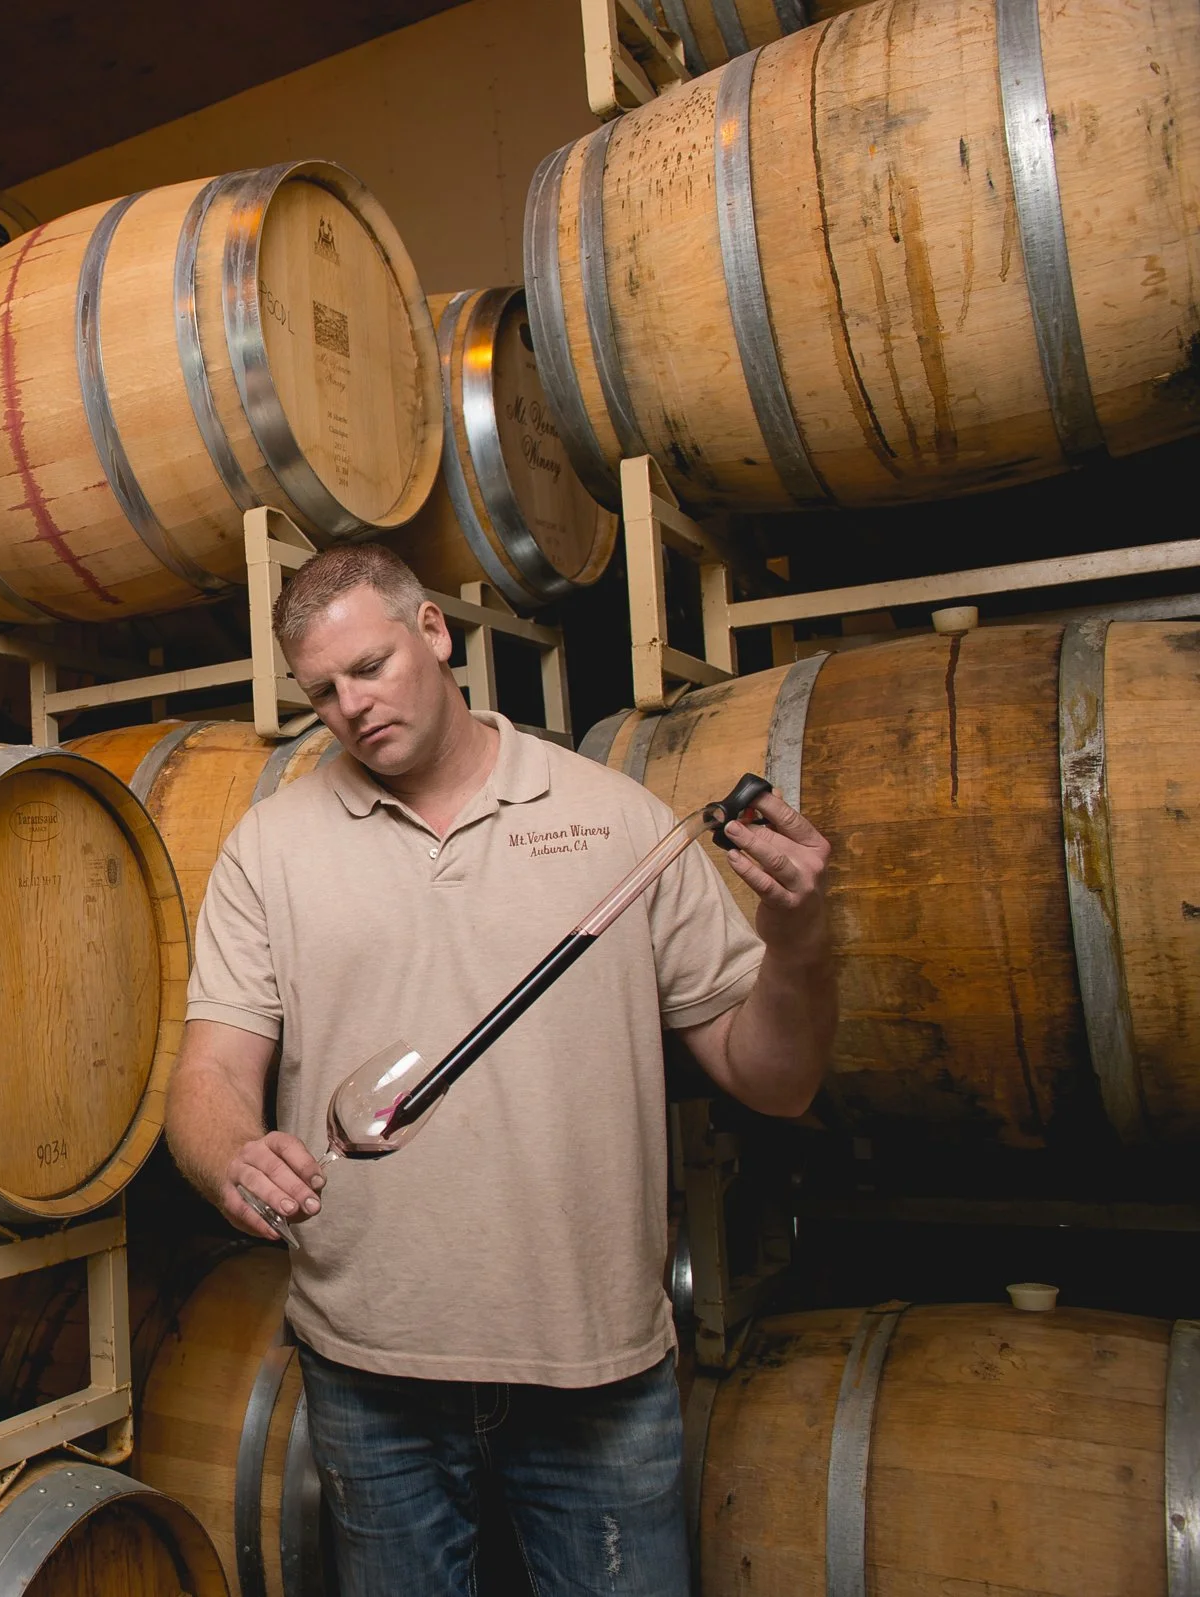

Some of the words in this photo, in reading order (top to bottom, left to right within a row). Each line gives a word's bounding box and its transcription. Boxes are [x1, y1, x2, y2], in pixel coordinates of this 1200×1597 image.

[16, 811, 58, 825] Taransaud
[509, 834, 527, 847] Mt.
[527, 832, 568, 844] Vernon
[570, 824, 610, 840] Winery
[530, 844, 573, 857] Auburn,
[574, 840, 588, 851] CA
[36, 1138, 67, 1168] 9034
